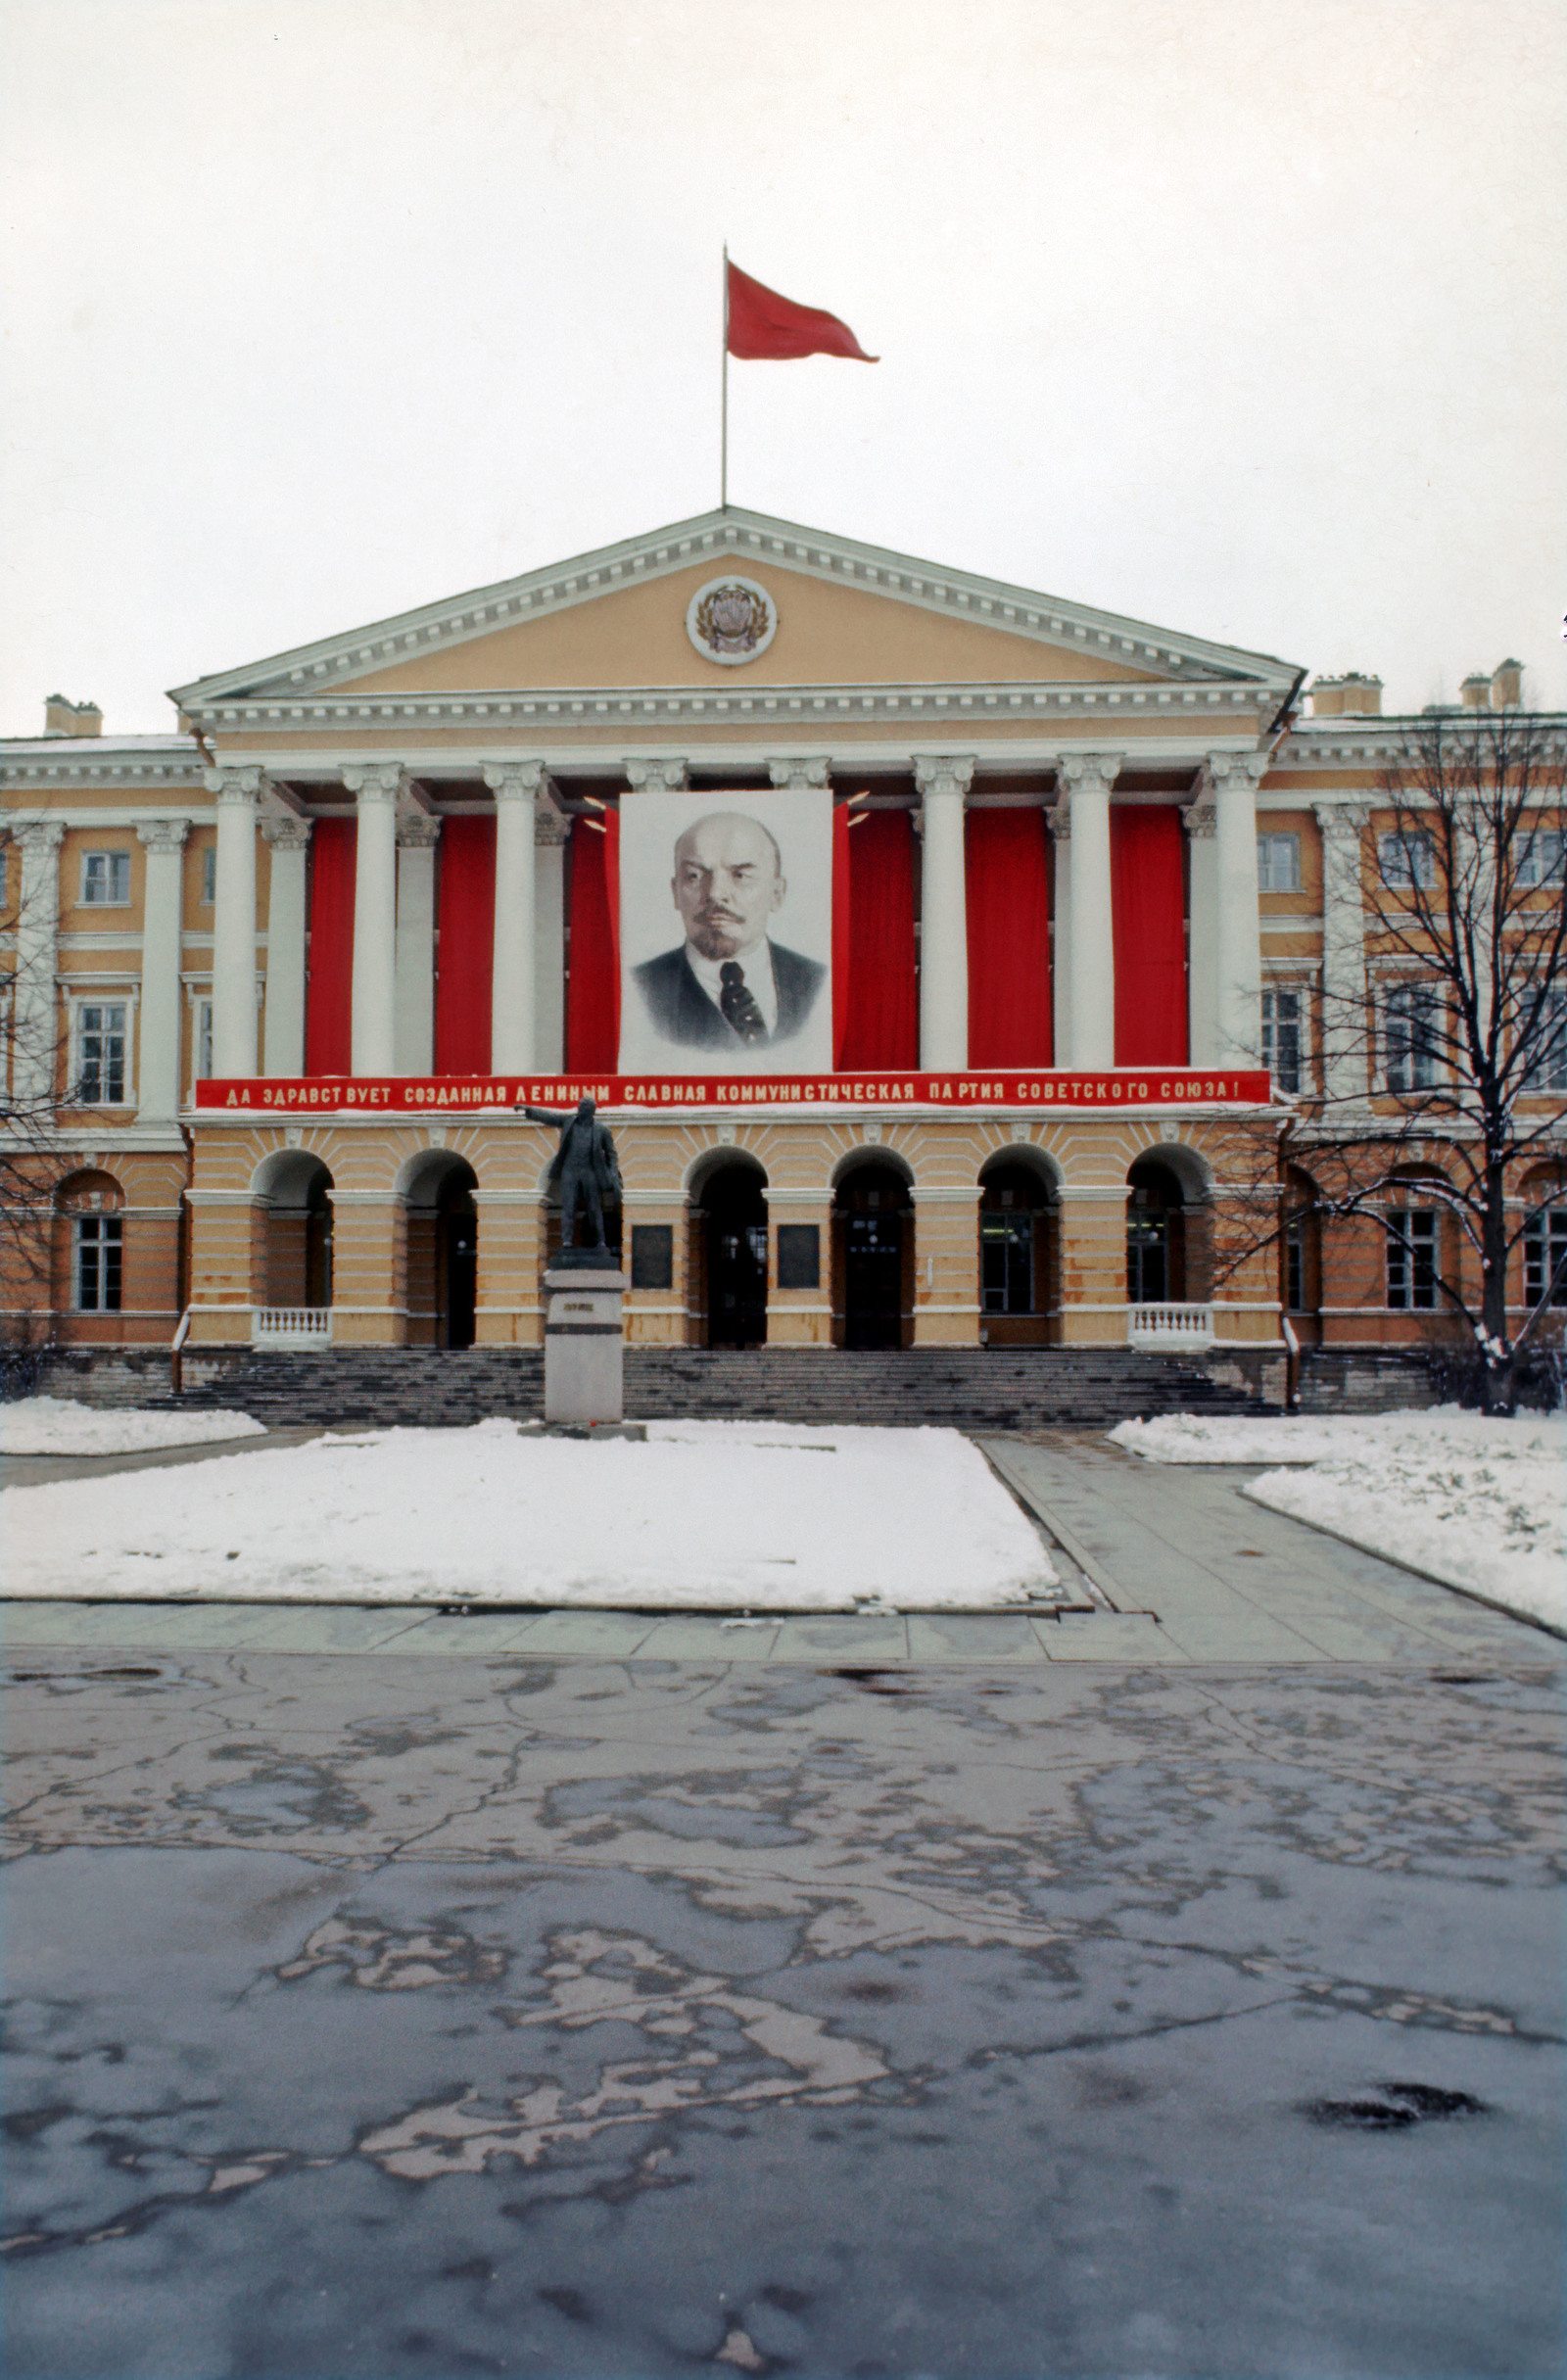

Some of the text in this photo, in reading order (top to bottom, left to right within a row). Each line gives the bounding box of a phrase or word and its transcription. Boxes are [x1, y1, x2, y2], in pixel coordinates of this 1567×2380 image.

[226, 1081, 1239, 1107] ДА ЗДРАВСТВУЕТ СОЗДАННАЯ ЛЕНИНЫМ СЛАВНАЯ КОММУНИСТИЧЕСКАЯ ПАРТИЯ СОВЕТСКОГО СОЮЗА!
